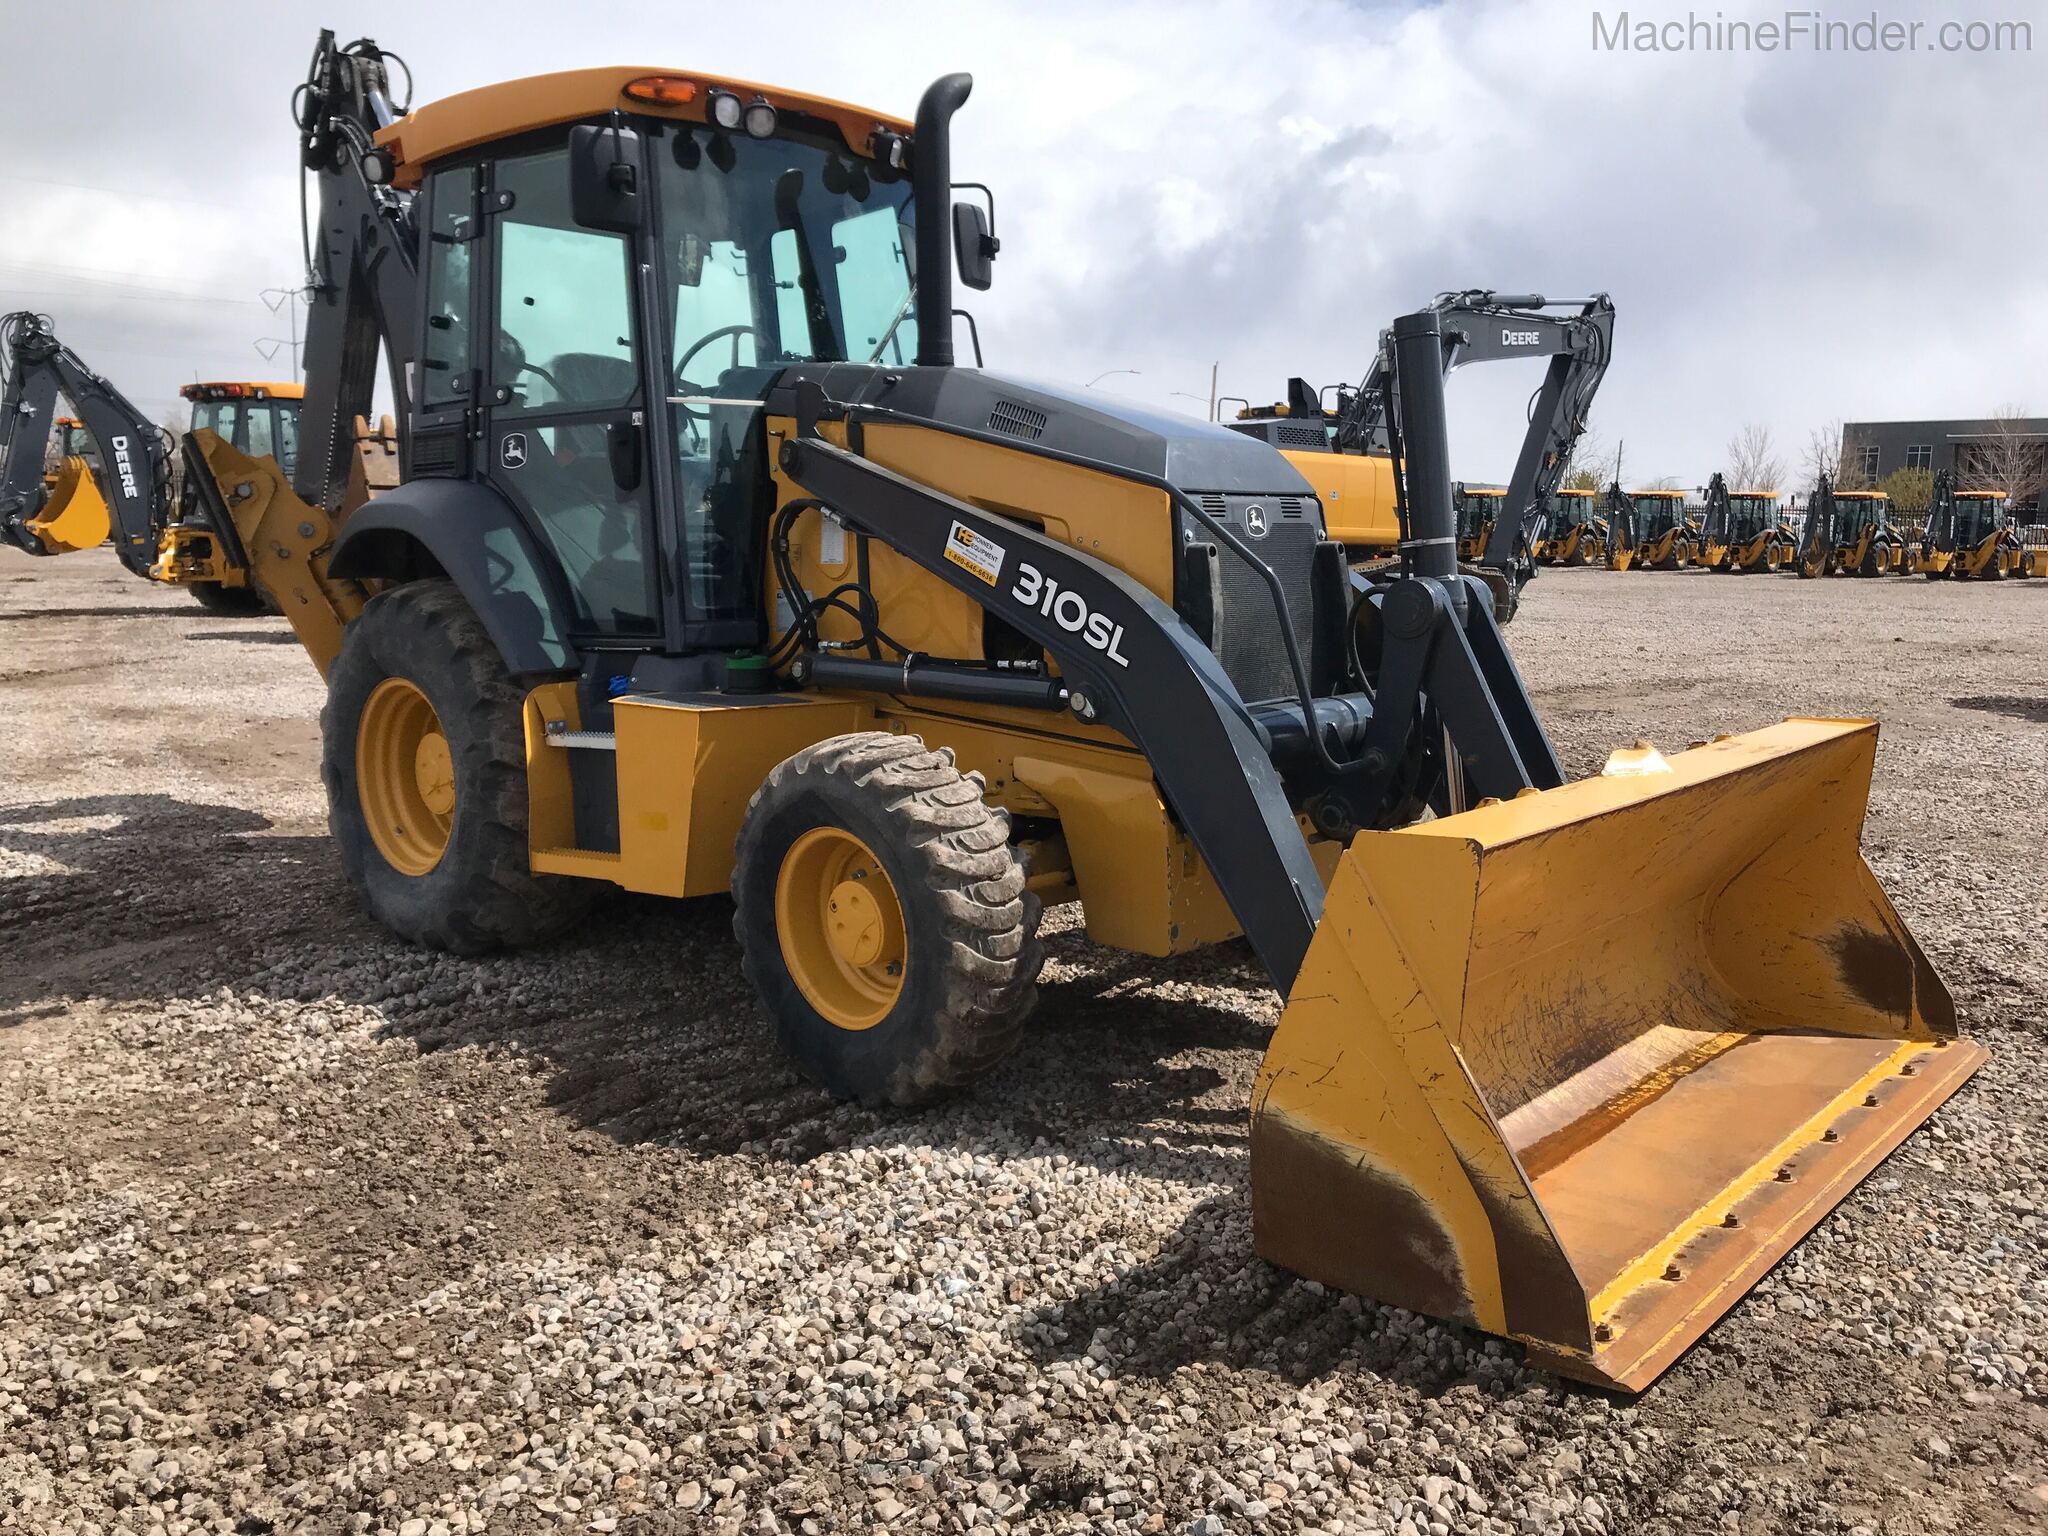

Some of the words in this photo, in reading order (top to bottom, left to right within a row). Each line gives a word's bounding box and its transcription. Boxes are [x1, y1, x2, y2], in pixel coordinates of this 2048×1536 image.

[1502, 329, 1540, 346] DEERE
[111, 435, 138, 499] DEERE
[970, 543, 998, 563] EQUIPMENT
[1011, 562, 1129, 668] 310SL
